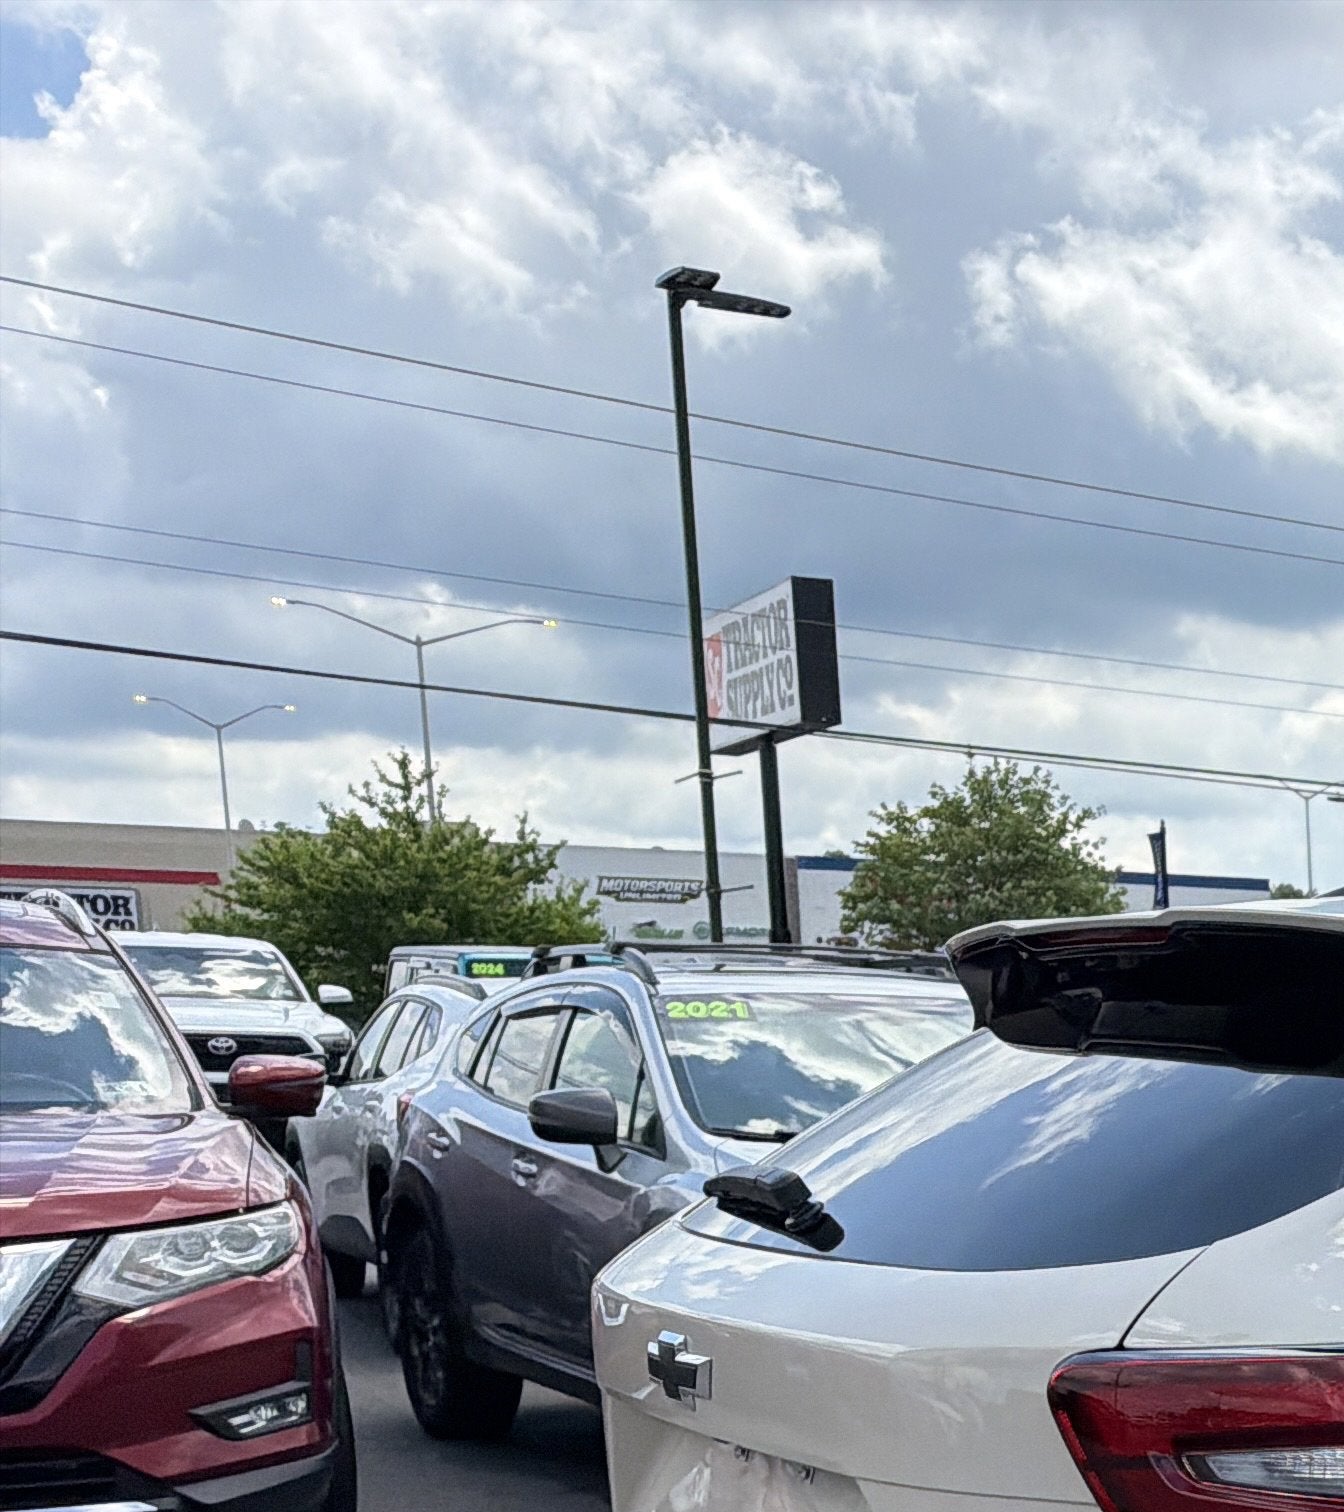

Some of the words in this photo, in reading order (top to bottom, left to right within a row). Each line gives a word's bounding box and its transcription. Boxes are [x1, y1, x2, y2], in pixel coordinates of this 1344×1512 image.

[722, 598, 791, 674] TRACTOR
[727, 662, 776, 719] SUPPLY
[600, 878, 700, 894] MOTORSPORTS
[471, 962, 505, 976] 2024
[666, 1001, 749, 1019] 2021
